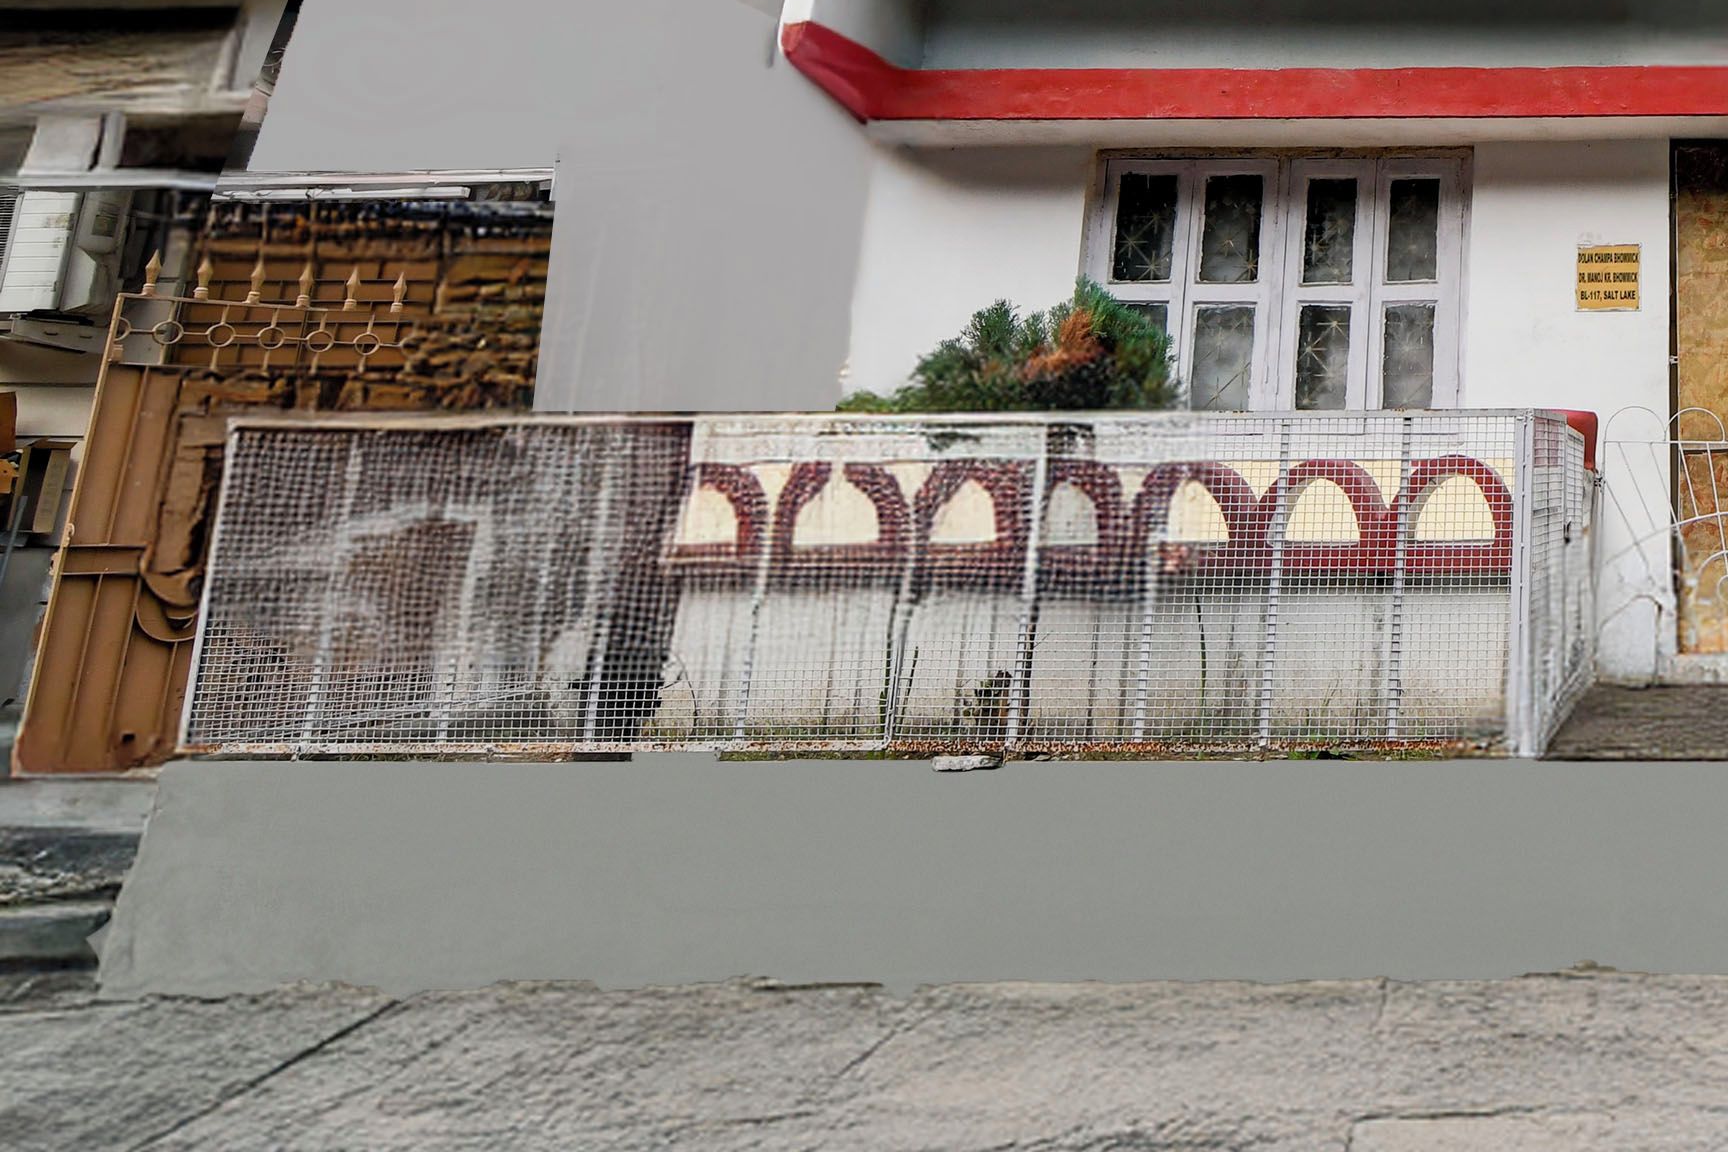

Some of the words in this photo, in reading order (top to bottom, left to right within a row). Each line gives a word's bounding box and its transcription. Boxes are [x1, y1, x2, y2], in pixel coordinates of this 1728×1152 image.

[1580, 291, 1602, 301] BL-117,
[1604, 291, 1619, 300] SALT
[1620, 291, 1636, 300] LAKE
